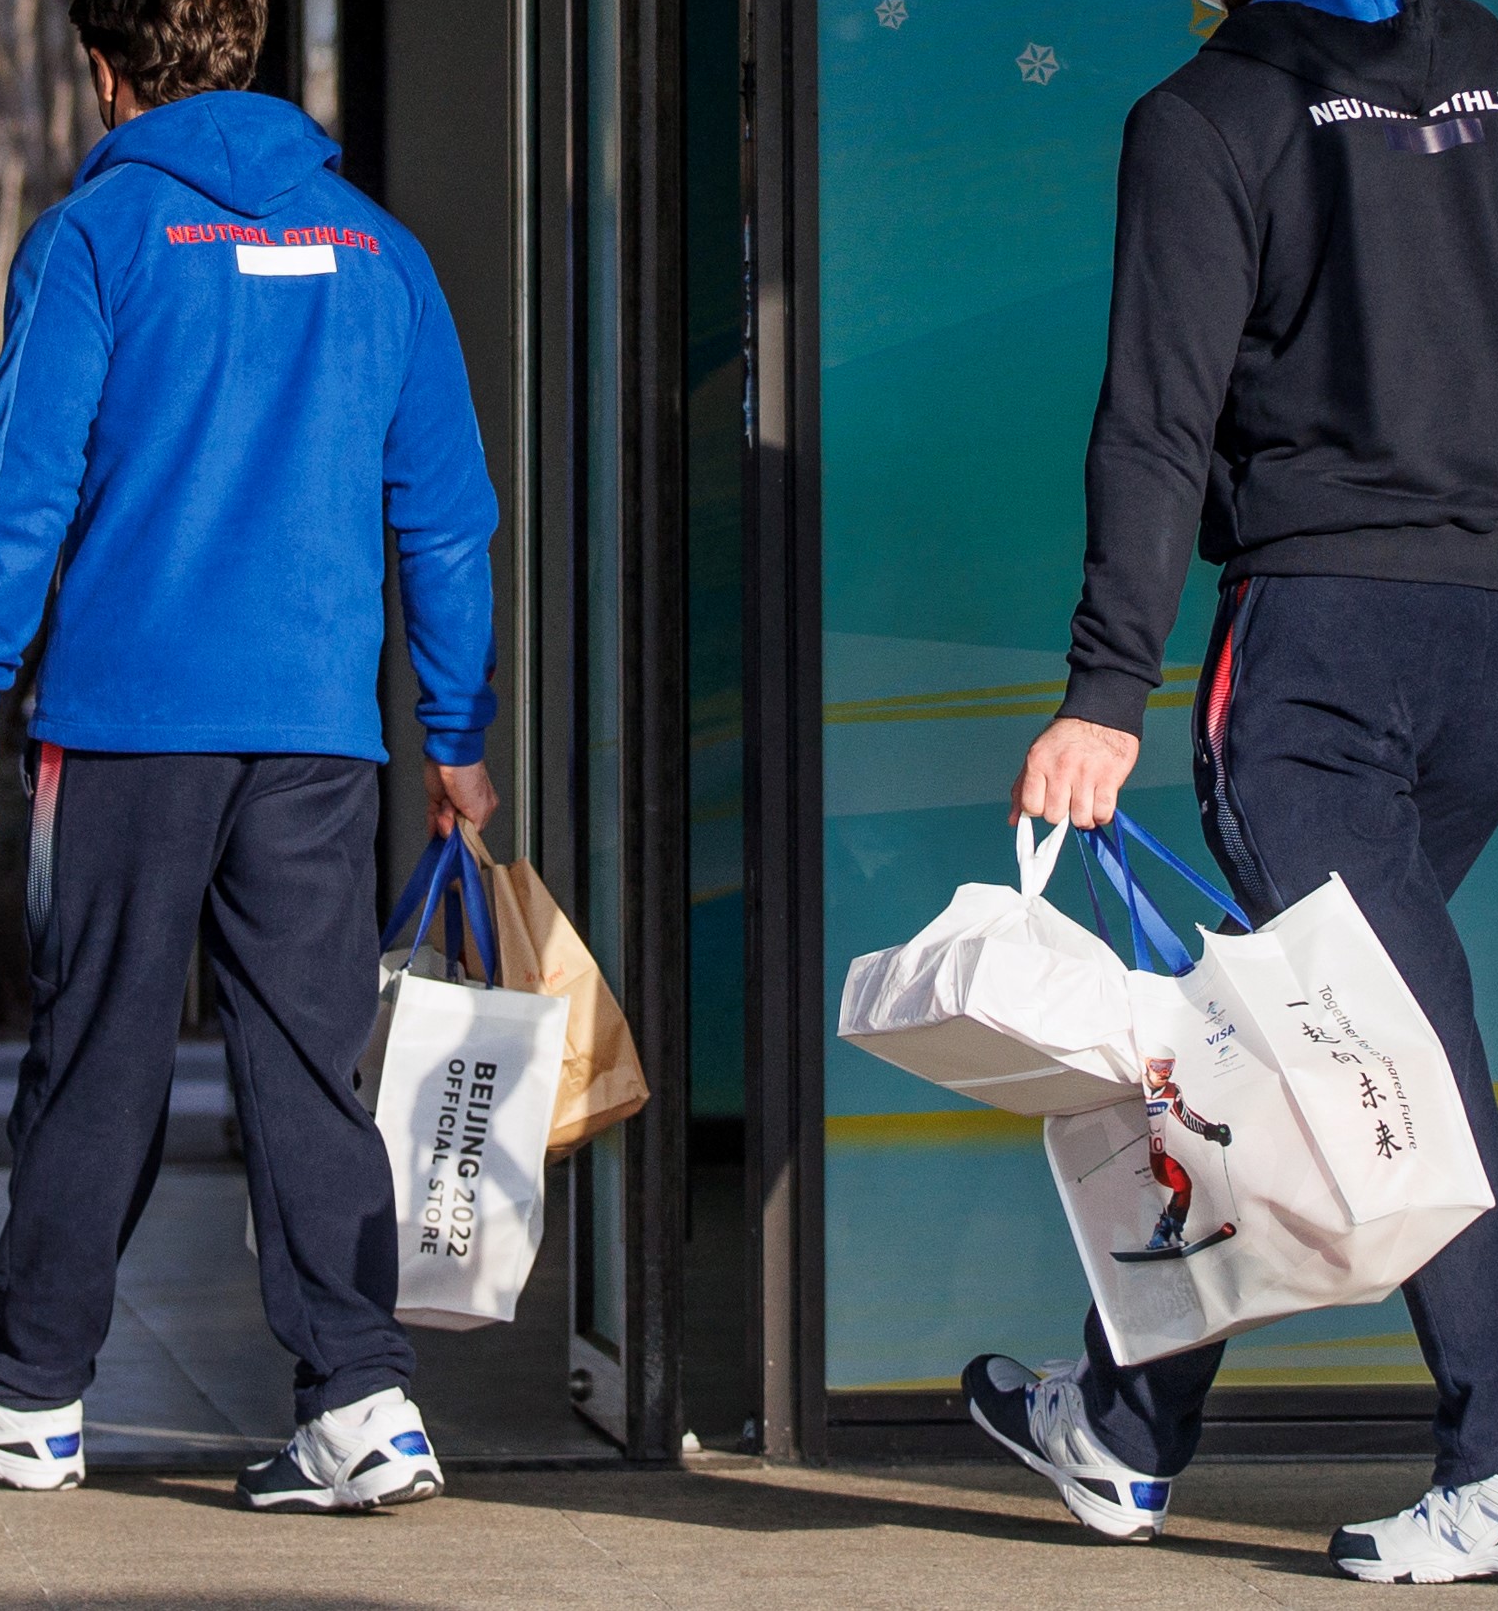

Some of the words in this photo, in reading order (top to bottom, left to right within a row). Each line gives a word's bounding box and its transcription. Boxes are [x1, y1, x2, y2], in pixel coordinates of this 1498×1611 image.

[166, 224, 276, 245] NEUTRAL
[283, 225, 380, 255] ATHLETE
[1205, 1023, 1236, 1046] VISA
[1318, 984, 1360, 1038] Together
[1377, 1055, 1407, 1101] Shared
[1400, 1103, 1418, 1150] Future
[432, 1059, 465, 1165] OFFICIAL
[457, 1061, 498, 1179] BEIJING
[420, 1177, 446, 1255] STORE
[446, 1188, 476, 1258] 2022
